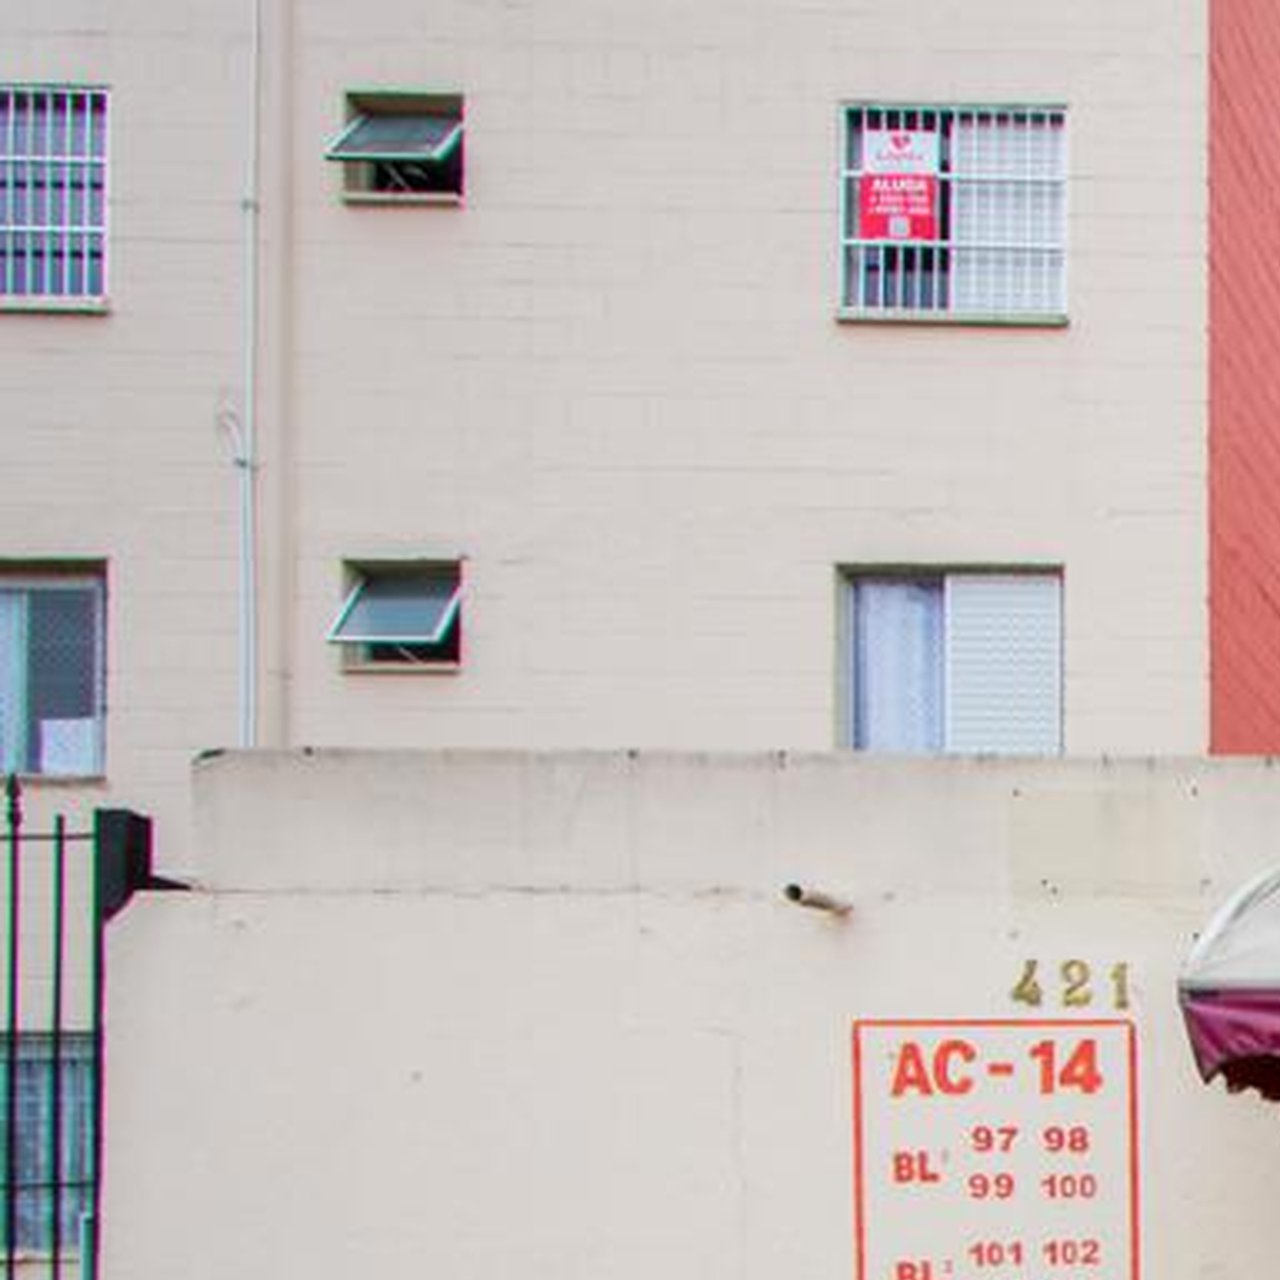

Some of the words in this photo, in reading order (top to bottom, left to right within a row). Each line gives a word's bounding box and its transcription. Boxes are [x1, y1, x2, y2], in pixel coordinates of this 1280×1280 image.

[1011, 959, 1129, 1010] 421
[971, 1126, 1019, 1153] 97
[1043, 1126, 1090, 1153] 98
[969, 1173, 1015, 1199] 99
[1040, 1175, 1097, 1199] 100
[968, 1241, 1026, 1267] 101
[1043, 1239, 1100, 1265] 102
